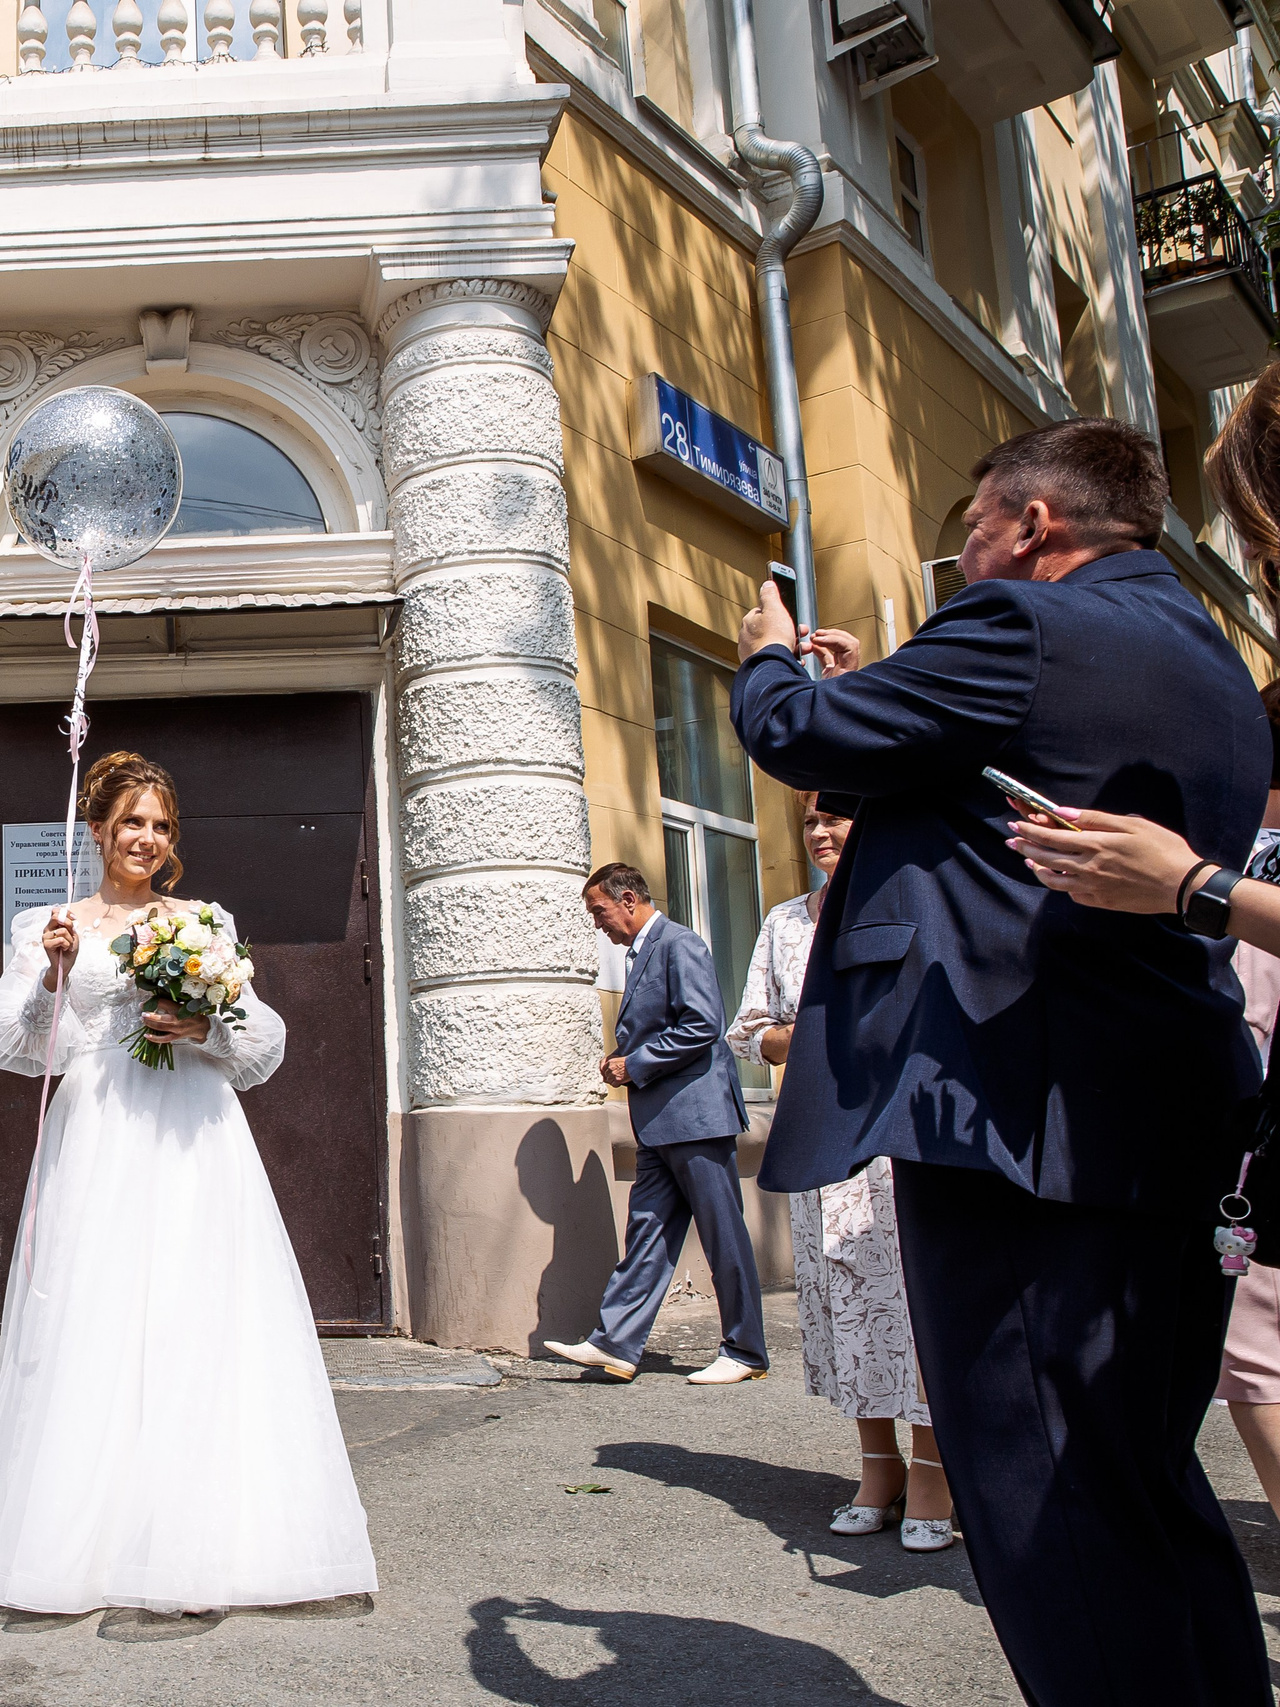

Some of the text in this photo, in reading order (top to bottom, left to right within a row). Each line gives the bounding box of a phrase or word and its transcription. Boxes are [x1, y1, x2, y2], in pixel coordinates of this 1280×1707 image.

[661, 412, 690, 461] 28
[692, 444, 761, 503] Тимирязева
[40, 830, 76, 838] Советск
[10, 840, 50, 850] Управления
[51, 840, 68, 848] ЗАГ
[35, 850, 58, 858] города
[14, 868, 56, 878] ПРИЕМ
[14, 886, 67, 895] Понедельник
[14, 900, 49, 909] Вторник
